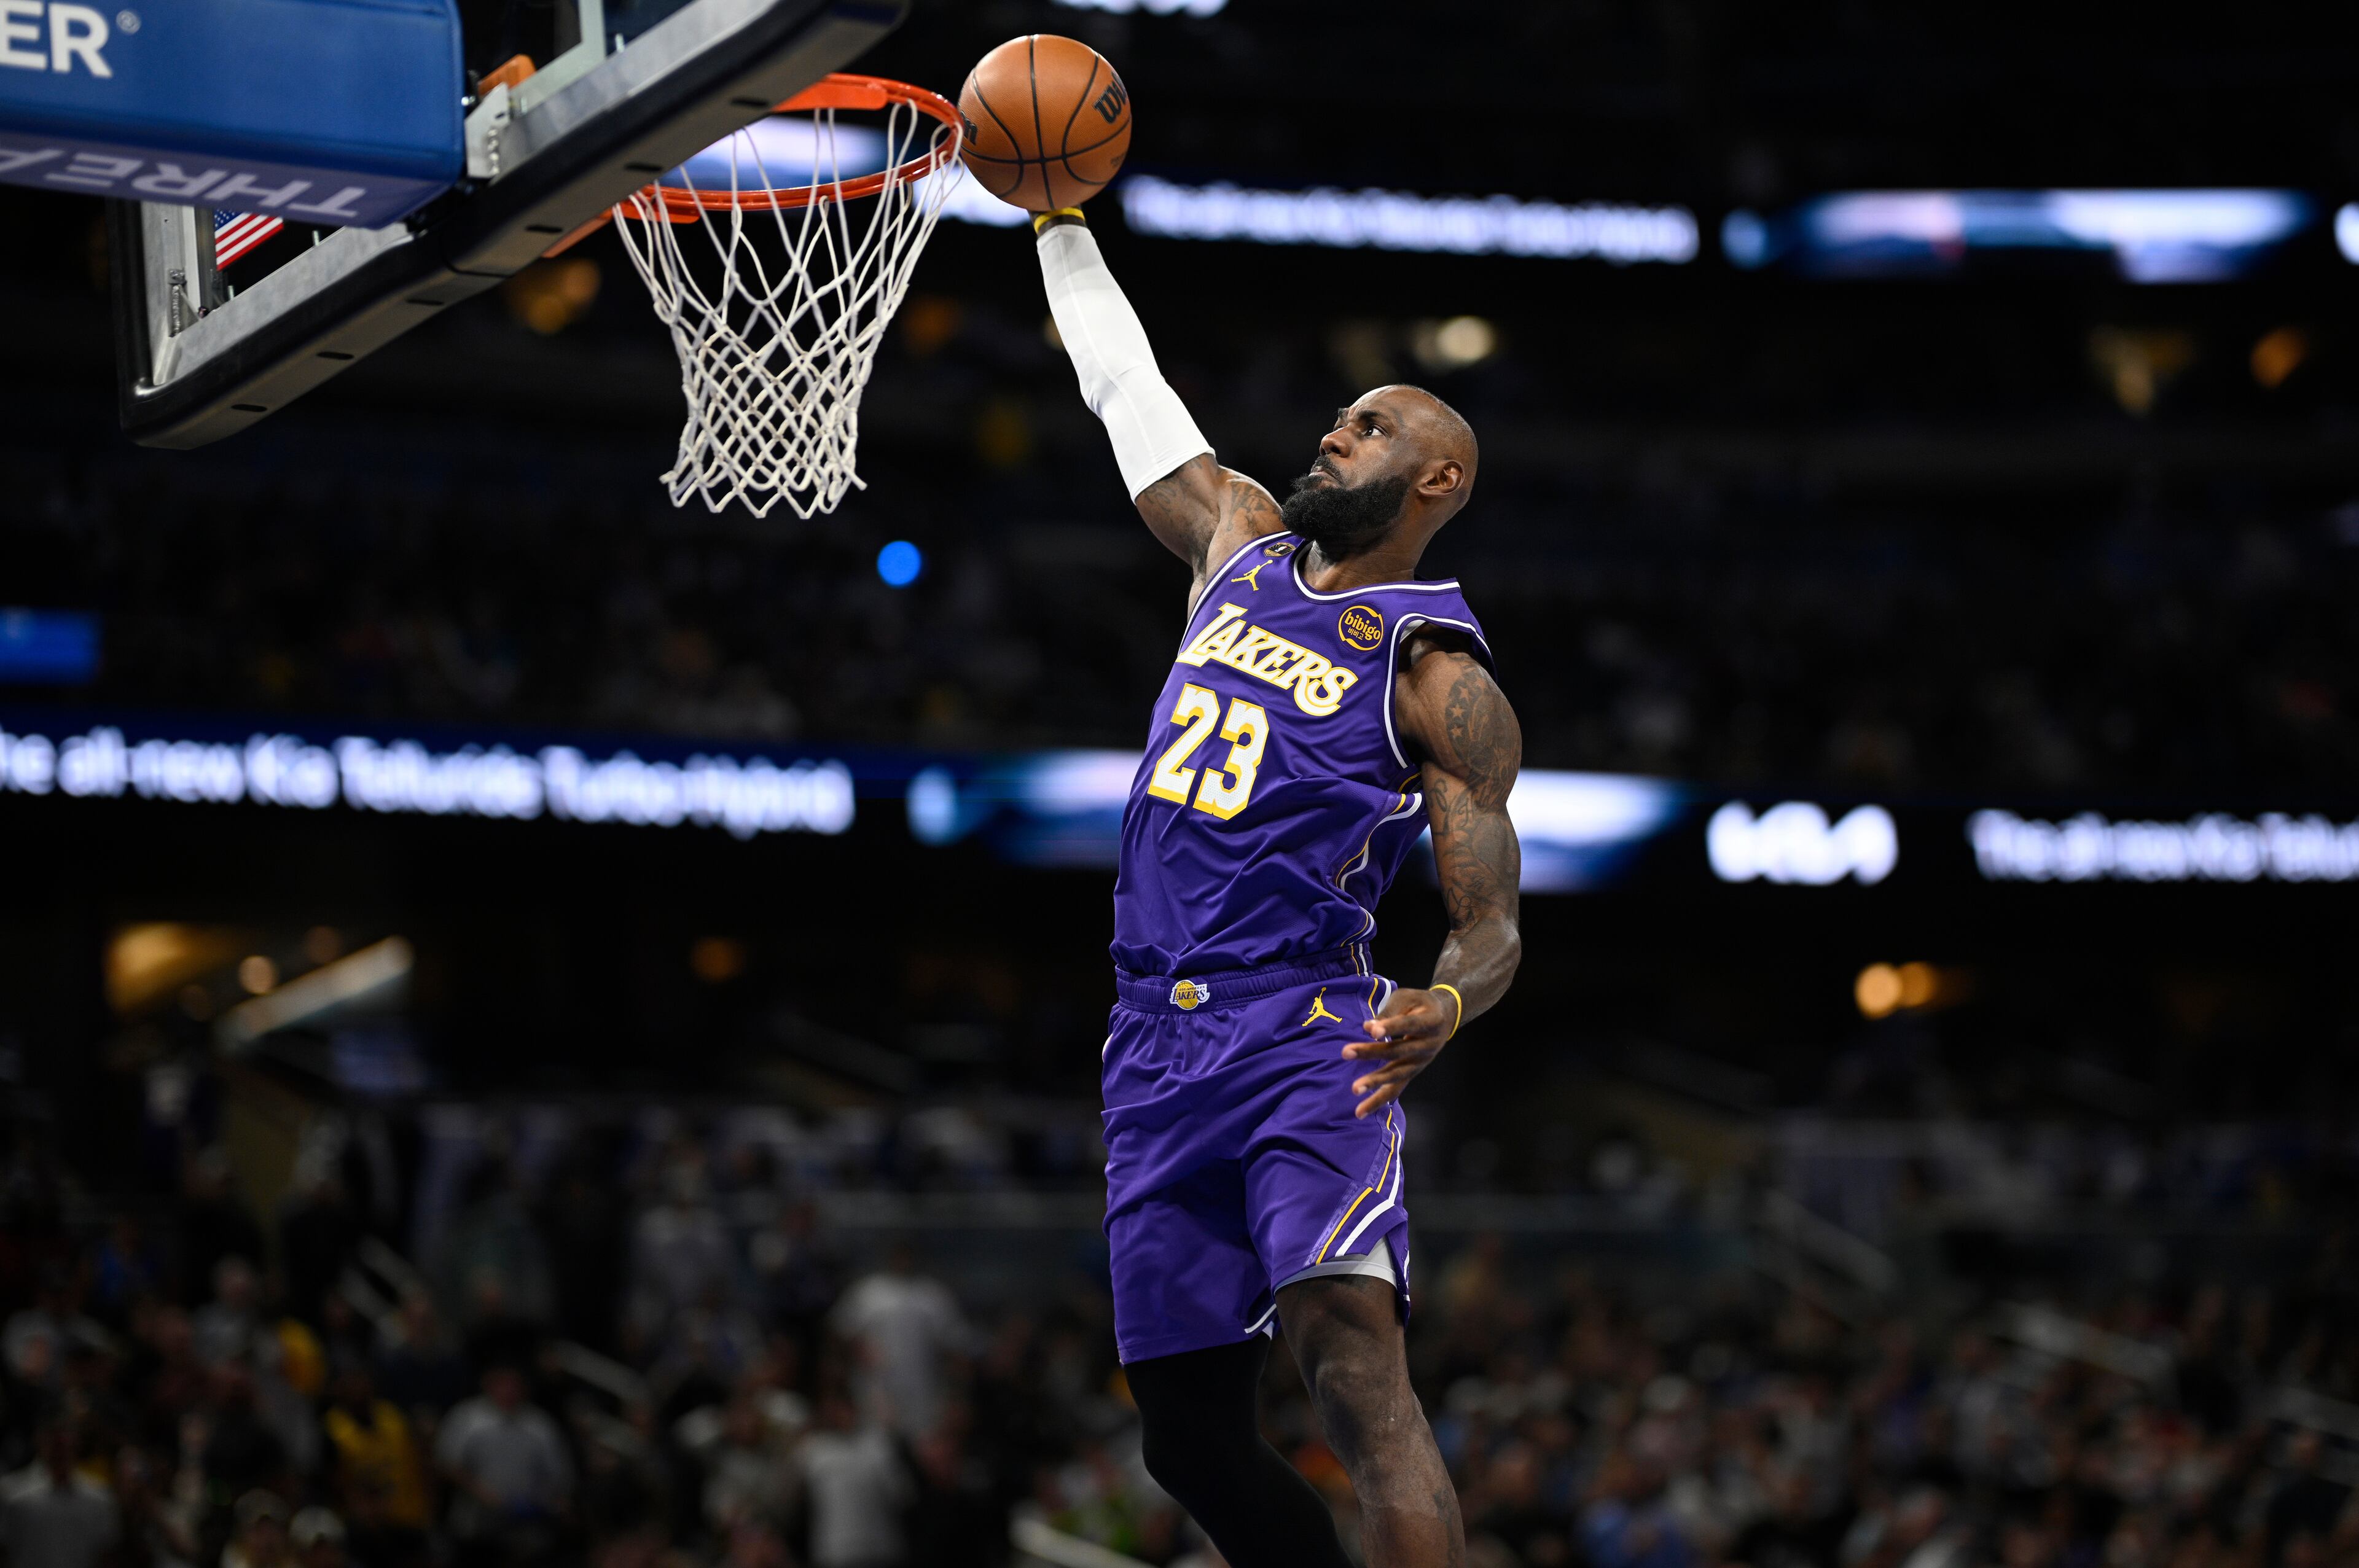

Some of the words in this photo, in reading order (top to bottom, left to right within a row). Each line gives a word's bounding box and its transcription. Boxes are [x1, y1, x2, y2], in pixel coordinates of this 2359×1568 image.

[1345, 612, 1381, 641] bibigo
[1347, 627, 1364, 640] 비비고
[1176, 603, 1358, 717] LAKERS
[1147, 683, 1269, 821] 23
[1172, 988, 1208, 1002] LAKERS
